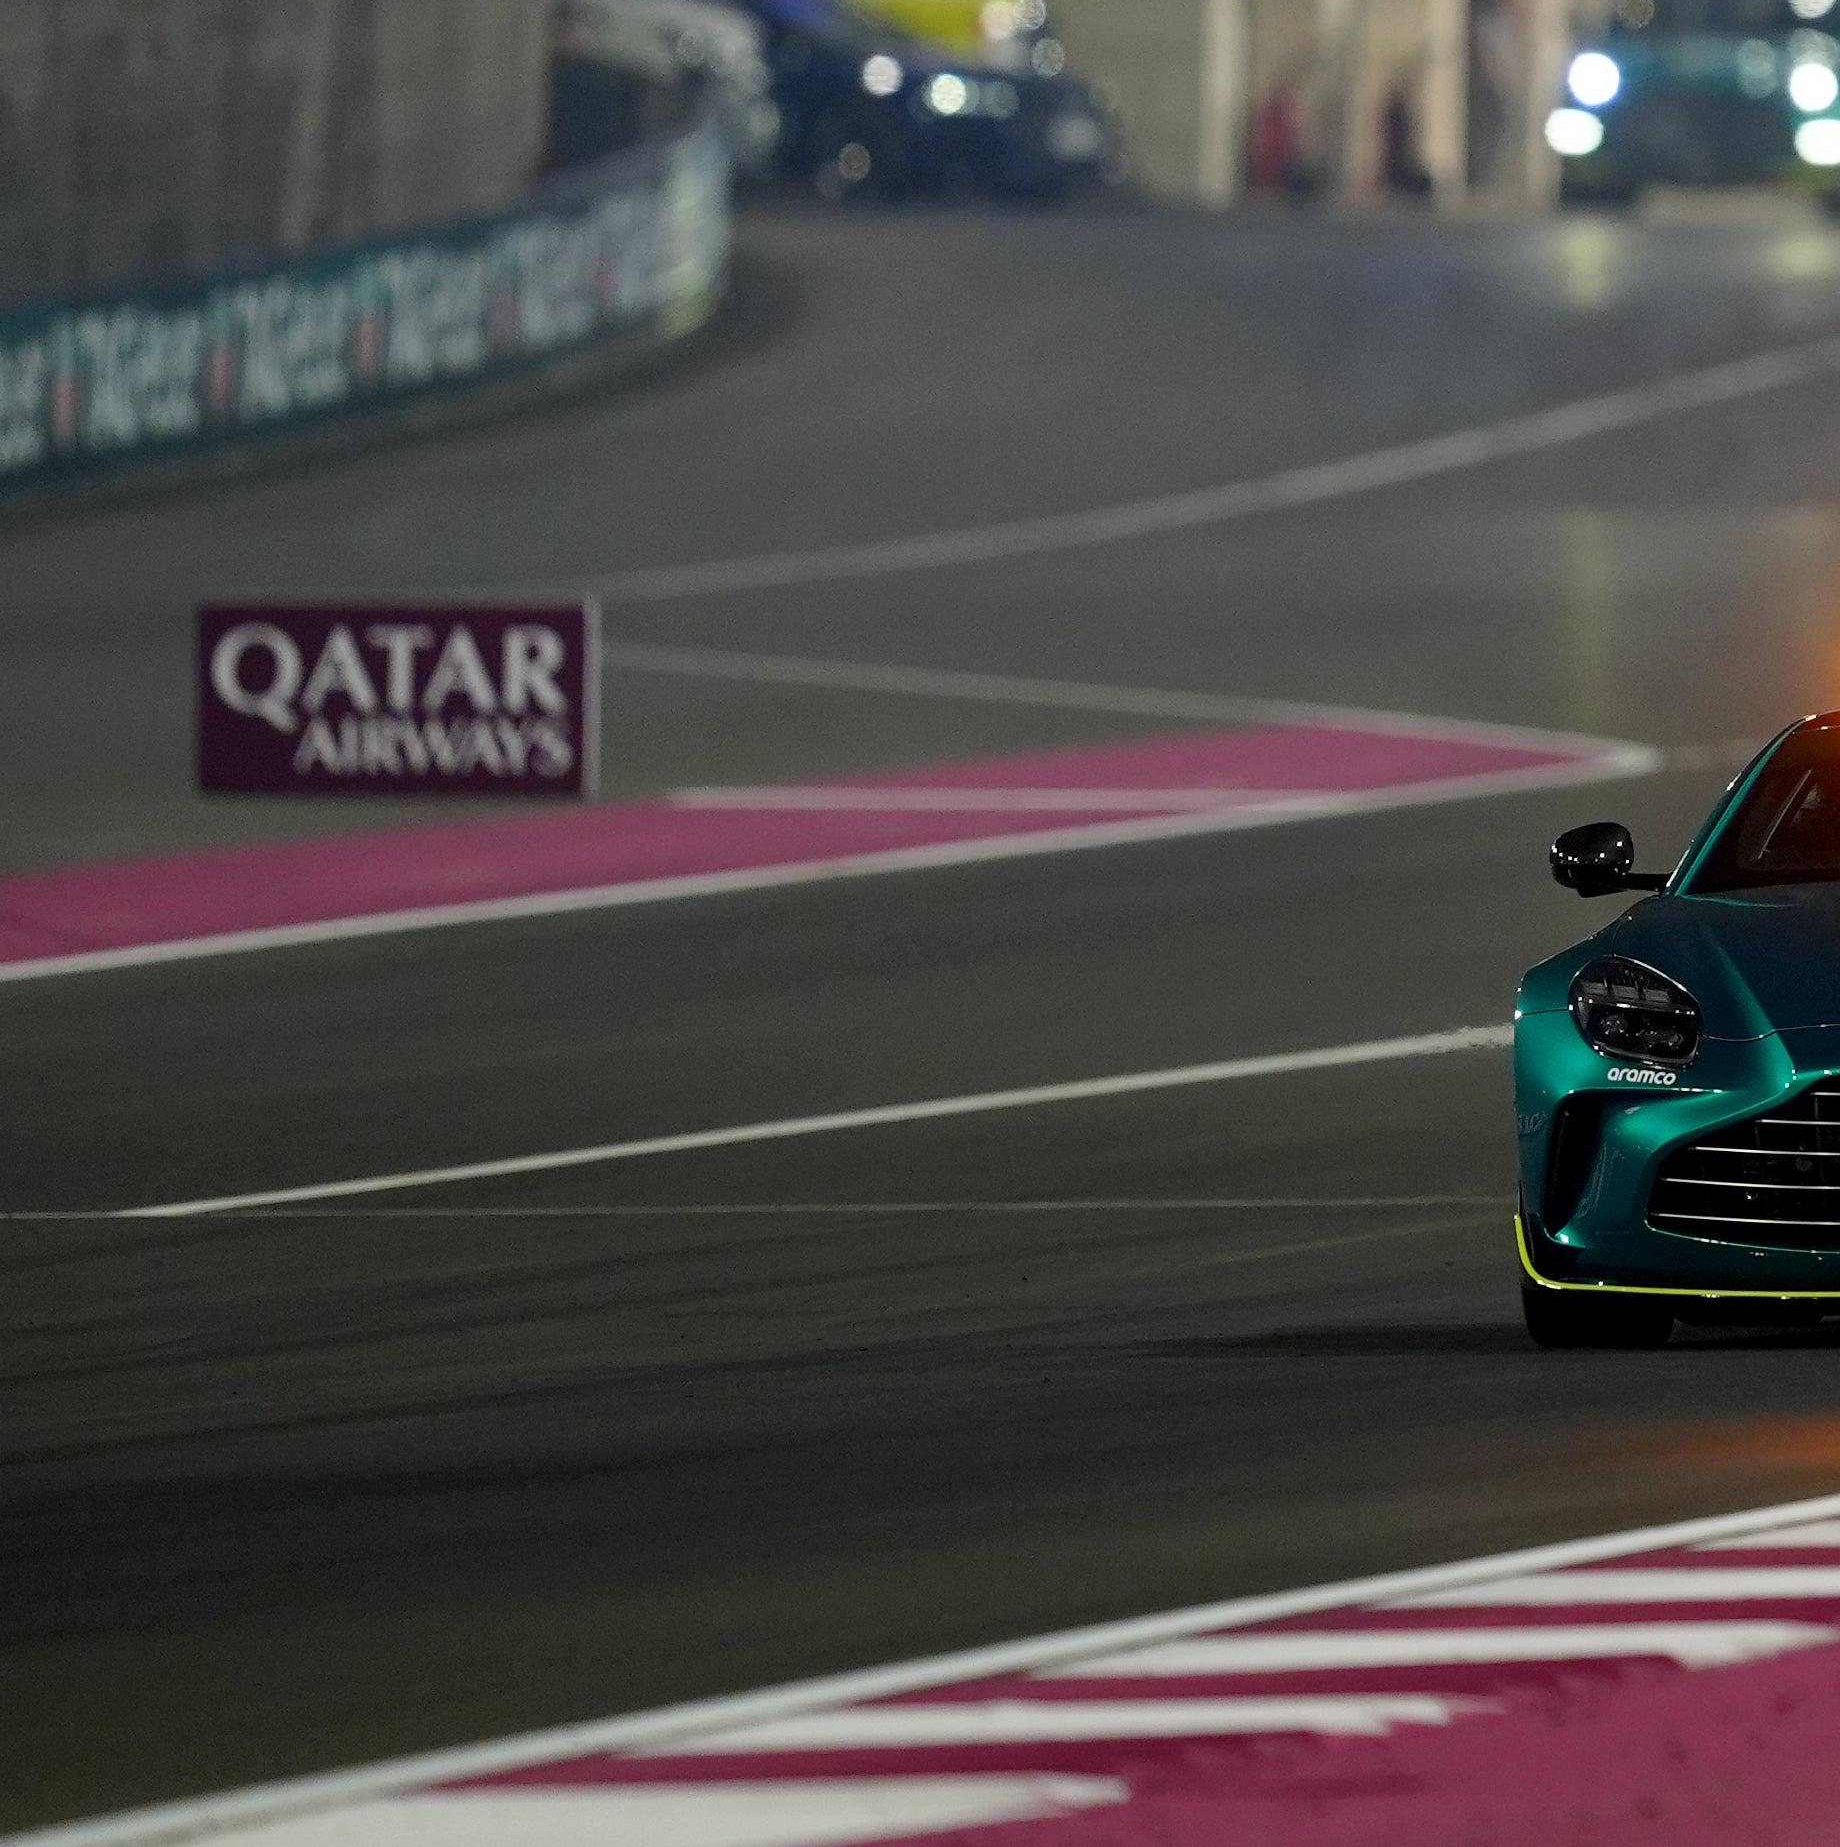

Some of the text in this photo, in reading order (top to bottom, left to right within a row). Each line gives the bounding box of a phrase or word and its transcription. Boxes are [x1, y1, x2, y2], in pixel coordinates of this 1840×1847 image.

[210, 621, 567, 733] QATAR
[293, 712, 574, 777] AIRWAYS
[1607, 1067, 1677, 1086] aramco
